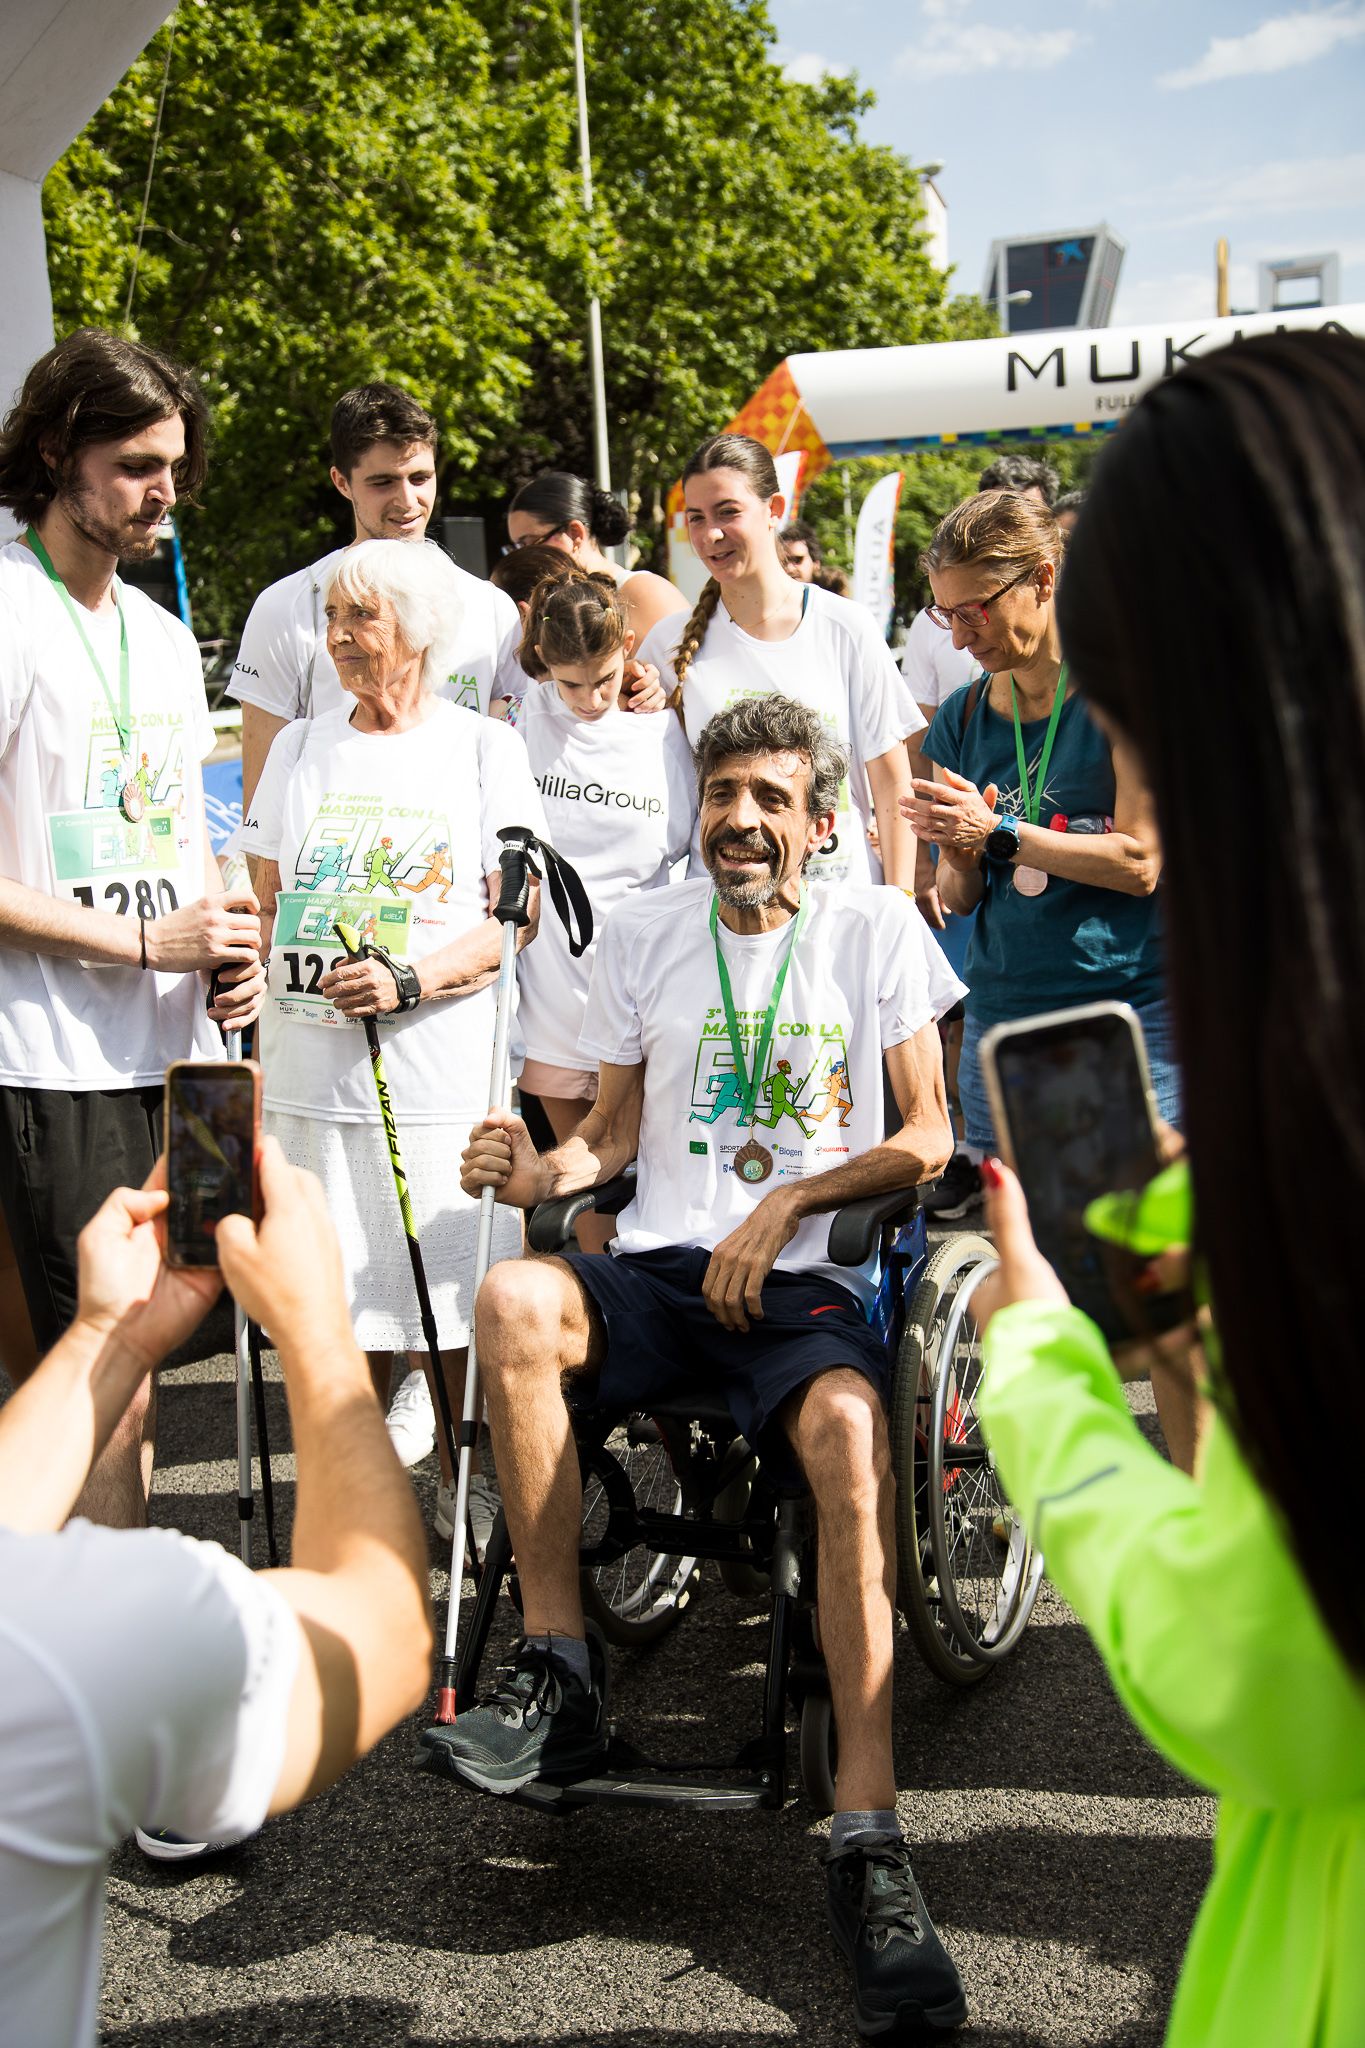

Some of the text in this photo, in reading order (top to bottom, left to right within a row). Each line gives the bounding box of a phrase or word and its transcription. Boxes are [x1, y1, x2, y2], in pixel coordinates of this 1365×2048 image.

[1006, 321, 1353, 391] MUK
[461, 674, 477, 687] LA
[140, 713, 164, 728] CON
[337, 792, 384, 803] Carrera
[317, 804, 450, 823] MADRID CON LA
[295, 816, 454, 886] ELA
[73, 878, 180, 921] 1280
[306, 897, 341, 907] MADRID
[283, 952, 347, 996] 12
[706, 1008, 721, 1019] 3ª
[777, 1022, 814, 1037] CON
[819, 1023, 843, 1037] LA
[376, 1078, 401, 1156] FIZAN
[778, 1146, 803, 1158] Biogen
